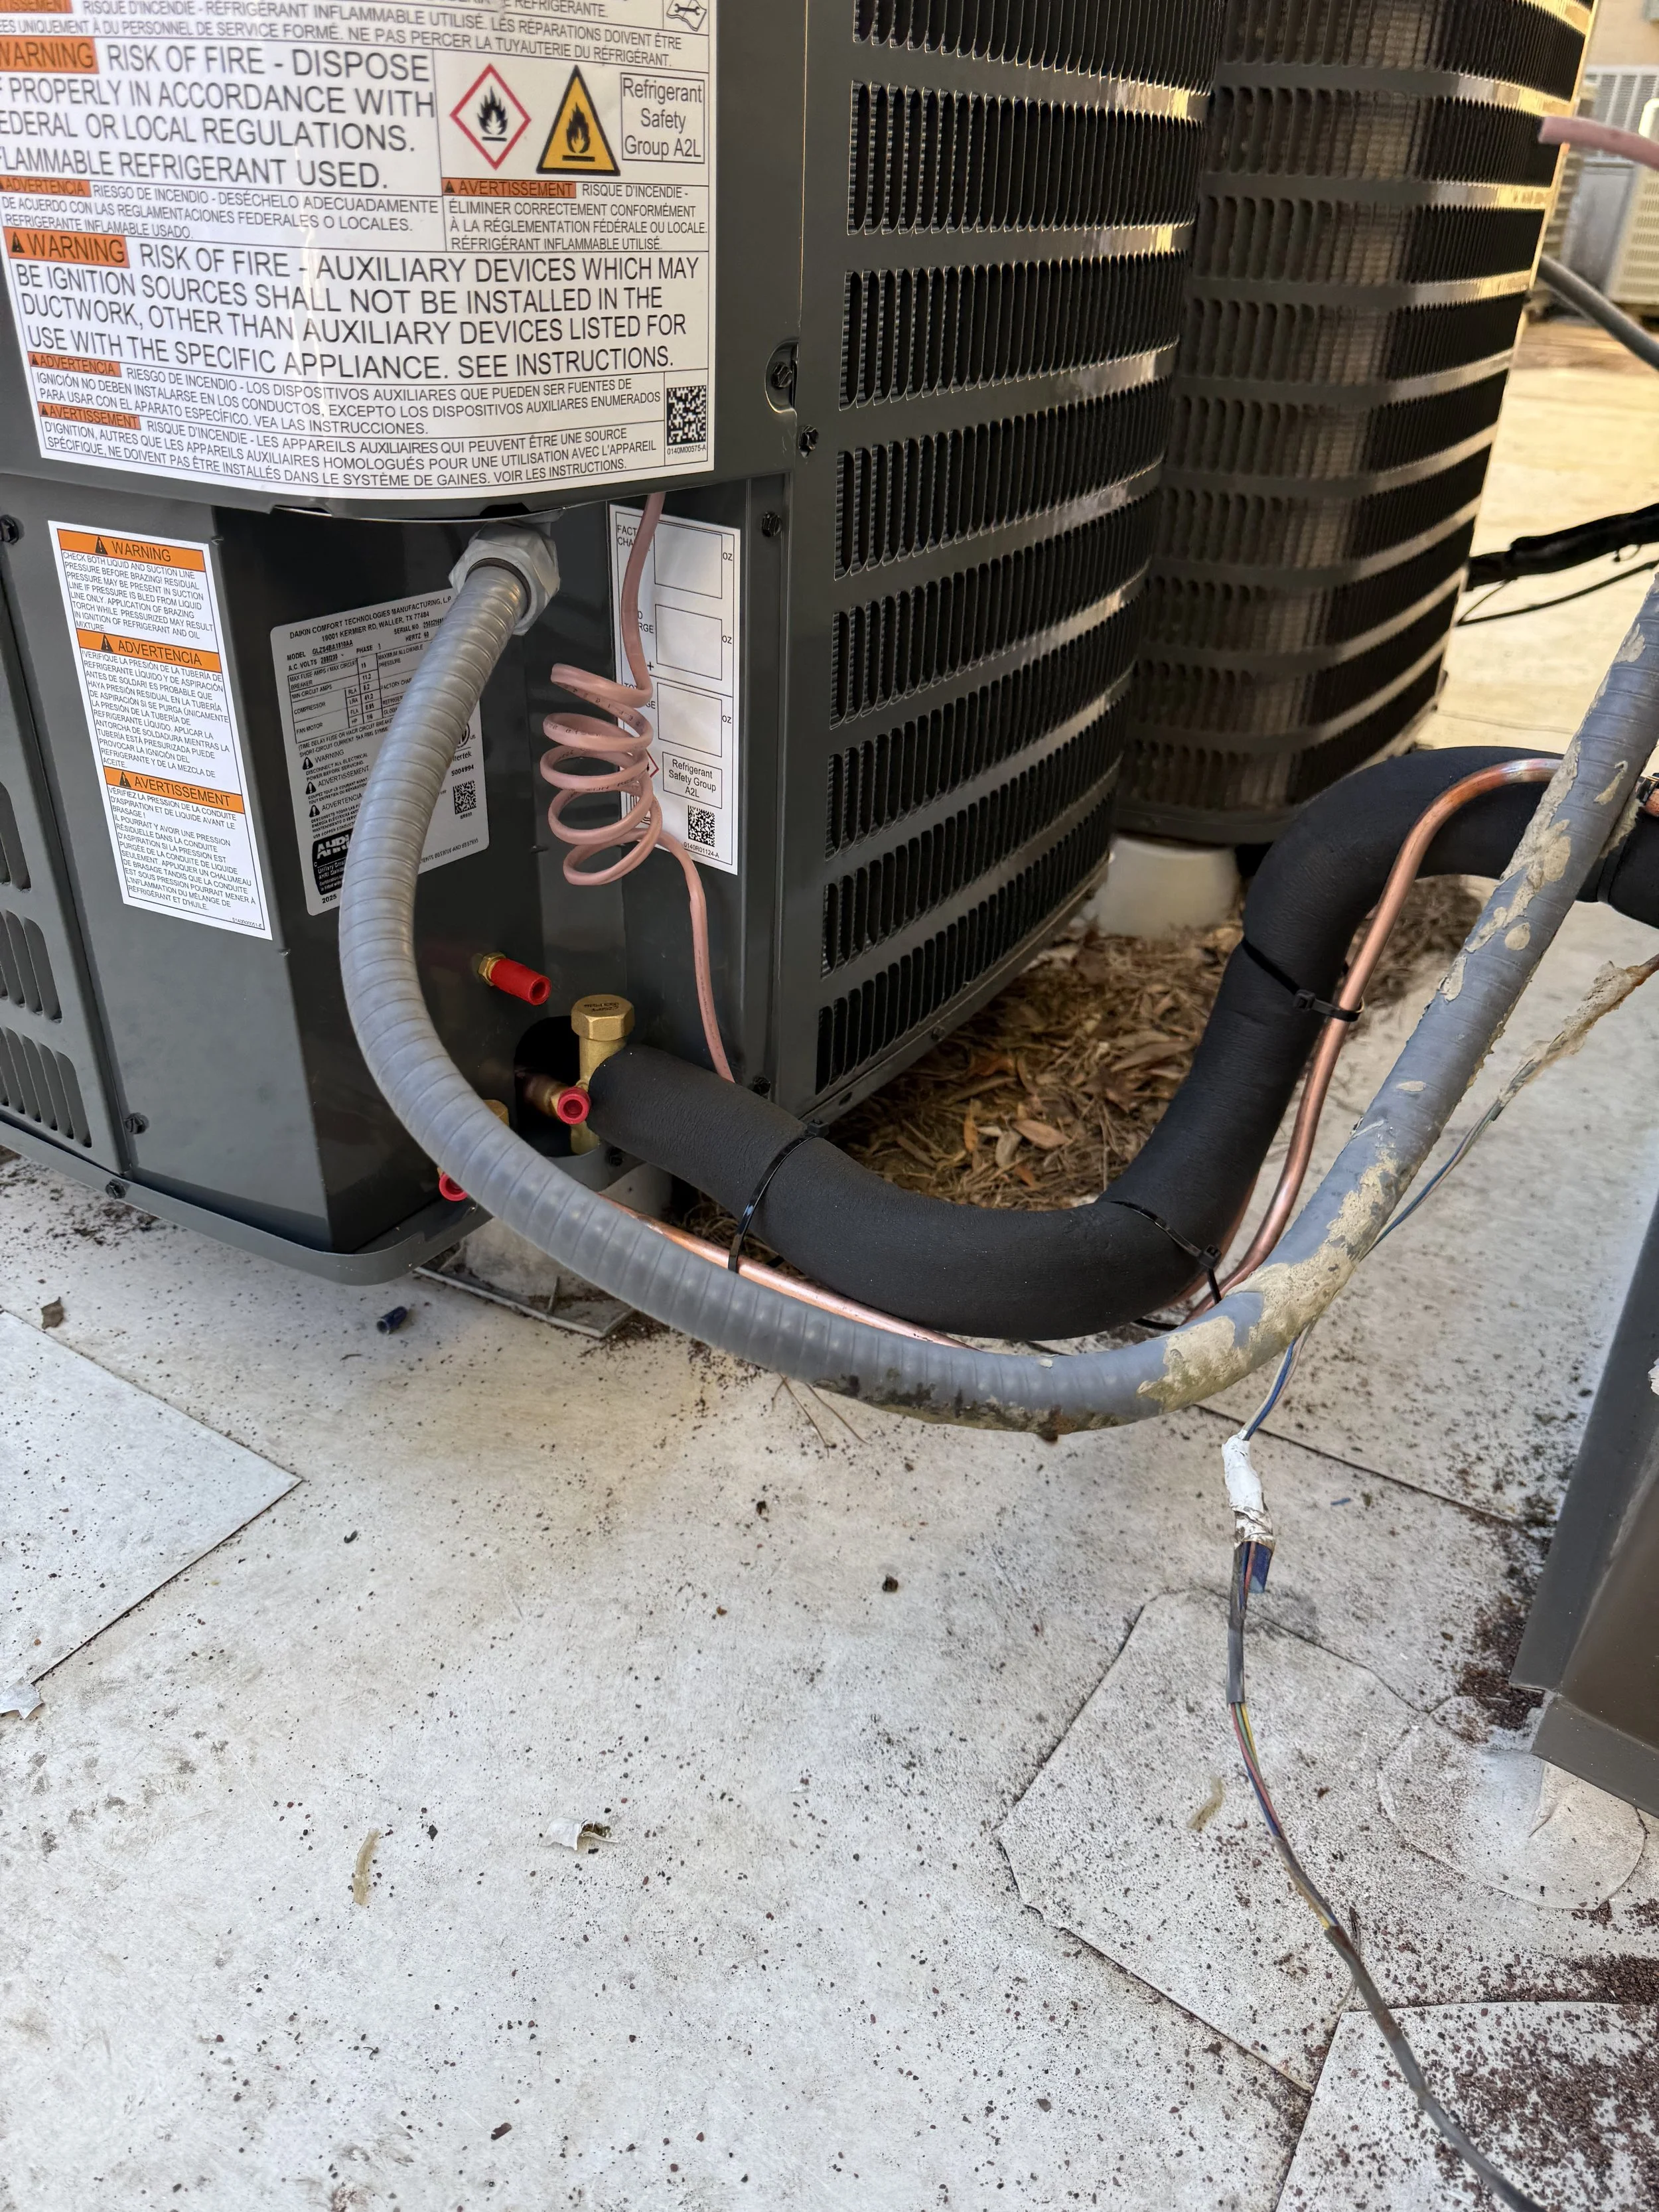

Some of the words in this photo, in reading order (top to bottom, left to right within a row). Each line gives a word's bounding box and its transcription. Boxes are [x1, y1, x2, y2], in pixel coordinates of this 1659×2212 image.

[107, 44, 160, 71] RISK
[166, 45, 195, 72] OF
[204, 46, 264, 74] FIRE
[292, 48, 429, 82] DISPOSE
[10, 77, 120, 105] PROPERLY
[129, 80, 151, 106] IN
[159, 81, 346, 113] ACCORDANCE
[354, 88, 435, 117] WITH
[622, 77, 702, 105] Refrigerant
[0, 110, 78, 137] EDERAL
[86, 113, 118, 139] OR
[123, 115, 196, 142] LOCAL
[202, 117, 414, 151] REGULATIONS.
[640, 108, 686, 134] Safety
[624, 135, 670, 161] Group
[674, 137, 701, 157] A2L
[0, 145, 113, 175] LAMMABLE
[118, 151, 286, 184] REFRIGERANT
[297, 160, 386, 188] USED.
[6, 179, 84, 194] ADVERTENCIA
[95, 184, 133, 198] RIESGO
[136, 187, 151, 200] DE
[155, 188, 208, 203] INCENDIO
[218, 190, 299, 208] DESÉCHELO
[303, 196, 438, 213] ADECUADAMENTE
[459, 183, 573, 196] AVERTISSEMENT
[582, 183, 622, 196] RISQUE
[626, 184, 682, 198] D'INCENDIE
[3, 196, 16, 208] DE
[19, 198, 67, 212] ACUERDO
[69, 201, 92, 214] CON
[94, 202, 115, 215] LAS
[117, 204, 234, 223] REGLAMENTACIONES
[238, 211, 319, 228] FEDERALES
[323, 215, 334, 228] O
[338, 216, 412, 230] LOCALES.
[449, 200, 510, 214] ÉLIMINER
[514, 202, 607, 216] CORRECTEMENT
[611, 202, 695, 217] CONFORMÉMENT
[450, 216, 459, 231] À
[463, 220, 479, 232] LA
[483, 217, 589, 232] RÉGLEMENTATION
[593, 218, 647, 232] FÉDÉRALE
[650, 222, 664, 233] OU
[668, 221, 709, 234] LOCALE.
[451, 235, 540, 251] RÉFRIGÉRANT
[544, 238, 619, 251] INFLAMMABLE
[622, 236, 662, 251] UTILISÉ.
[29, 234, 125, 263] WARNING
[139, 243, 190, 269] RISK
[196, 248, 224, 272] OF
[232, 250, 289, 277] FIRE
[317, 255, 465, 281] AUXILIARY
[475, 258, 575, 282] DEVICES
[582, 257, 651, 280] WHICH
[658, 257, 698, 279] MAY
[17, 263, 42, 288] BE
[46, 266, 135, 296] IGNITION
[141, 274, 247, 305] SOURCES
[255, 283, 341, 311] SHALL
[350, 289, 410, 313] NOT
[421, 290, 457, 313] BE
[467, 288, 591, 313] INSTALLED
[599, 287, 616, 309] IN
[623, 287, 662, 309] THE
[23, 293, 142, 329] DUCTWORK,
[149, 305, 222, 334] OTHER
[226, 313, 293, 339] THAN
[303, 319, 450, 344] AUXILIARY
[460, 318, 562, 344] DEVICES
[570, 315, 640, 339] LISTED
[647, 313, 685, 336] FOR
[27, 325, 67, 350] USE
[70, 330, 122, 356] WITH
[127, 336, 169, 362] THE
[175, 341, 275, 373] SPECIFIC
[284, 352, 447, 378] APPLIANCE.
[458, 354, 508, 378] SEE
[516, 345, 672, 376] INSTRUCTIONS.
[40, 355, 115, 374] ADVERTENCIA
[126, 367, 165, 382] RIESGO
[168, 372, 183, 384] DE
[185, 374, 236, 391] INCENDIO
[246, 381, 269, 394] LOS
[273, 384, 368, 400] DISPOSITIVOS
[373, 389, 456, 400] AUXILIARES
[461, 388, 488, 400] QUE
[492, 385, 540, 398] PUEDEN
[543, 383, 565, 396] SER
[568, 379, 614, 393] FUENTES
[618, 378, 631, 390] DE
[50, 406, 137, 428] AVERTISSEMENT
[667, 444, 707, 455] 0140M00575-A
[617, 524, 637, 536] FACT
[111, 541, 171, 563] WARNING
[723, 552, 733, 561] OZ
[62, 552, 86, 561] CHECK
[86, 555, 105, 565] BOTH
[106, 558, 129, 568] LIQUID
[131, 562, 145, 571] AND
[146, 565, 177, 576] SUCTION
[179, 569, 194, 579] LINE
[65, 561, 100, 573] PRESSURE
[102, 567, 129, 578] BEFORE
[130, 571, 162, 583] BRAZING!
[164, 577, 199, 589] RESIDUAL
[405, 632, 421, 642] HERTZ
[722, 635, 732, 644] OZ
[118, 640, 202, 665] ADVERTENCIA
[287, 651, 306, 661] MODEL
[356, 644, 373, 654] PHASE
[300, 659, 317, 669] VOLTS
[722, 715, 732, 724] OZ
[315, 749, 344, 763] WARNING
[451, 765, 474, 776] 5004994
[672, 759, 713, 778] Refrigerant
[135, 776, 230, 806] AVERTISSEMENT
[669, 769, 691, 785] Safety
[693, 777, 716, 793] Group
[685, 786, 699, 798] A2L
[322, 793, 362, 811] ADVERTENCIA
[684, 842, 719, 859] 0140R01124-A
[322, 894, 337, 904] 2025
